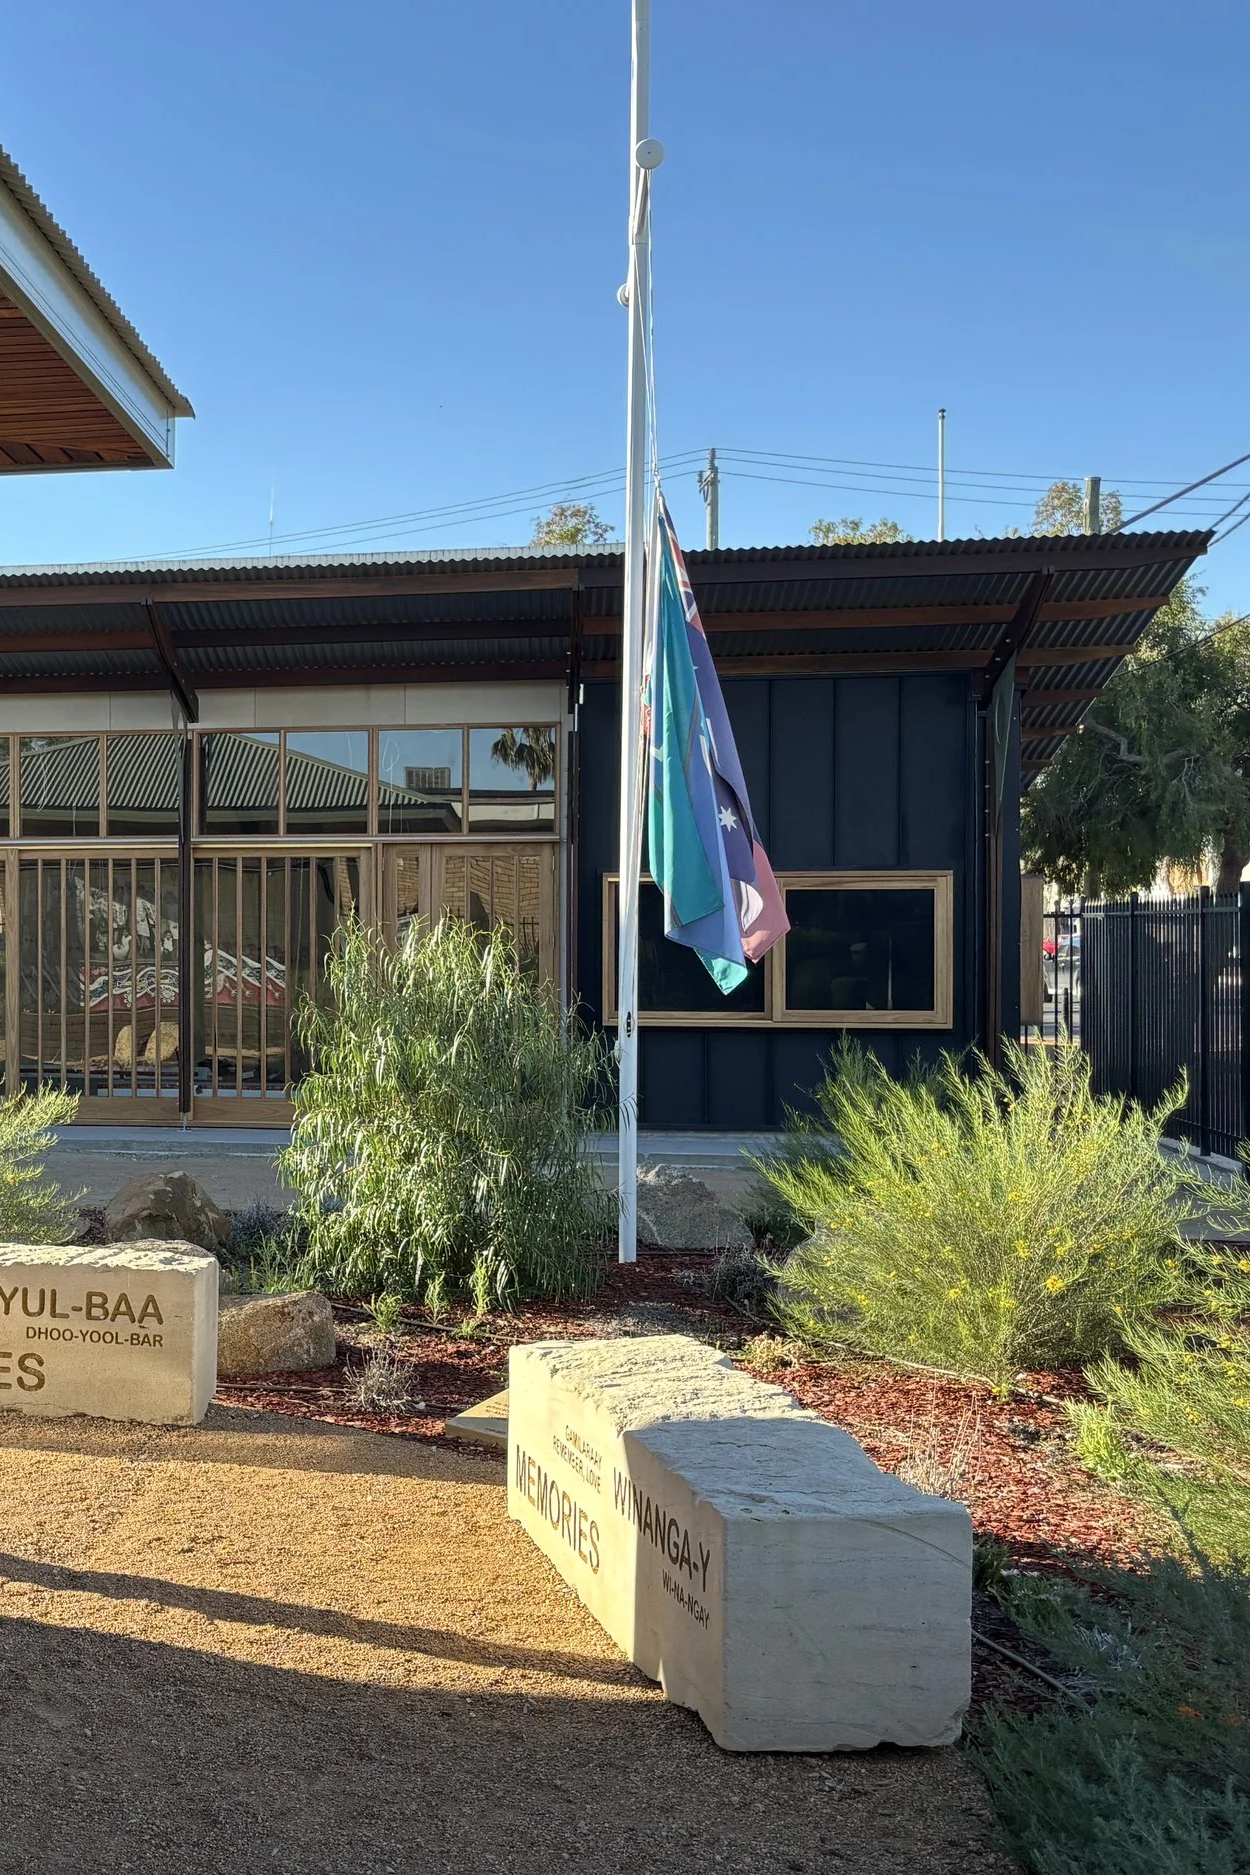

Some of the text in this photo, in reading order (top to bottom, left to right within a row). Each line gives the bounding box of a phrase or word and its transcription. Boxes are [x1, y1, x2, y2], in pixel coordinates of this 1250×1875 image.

[25, 1325, 164, 1348] DHOO-YOOL-BAR
[515, 1444, 600, 1575] MEMORIES
[613, 1466, 711, 1593] WINANGA-Y
[662, 1568, 711, 1631] WI-NA-NGAY
